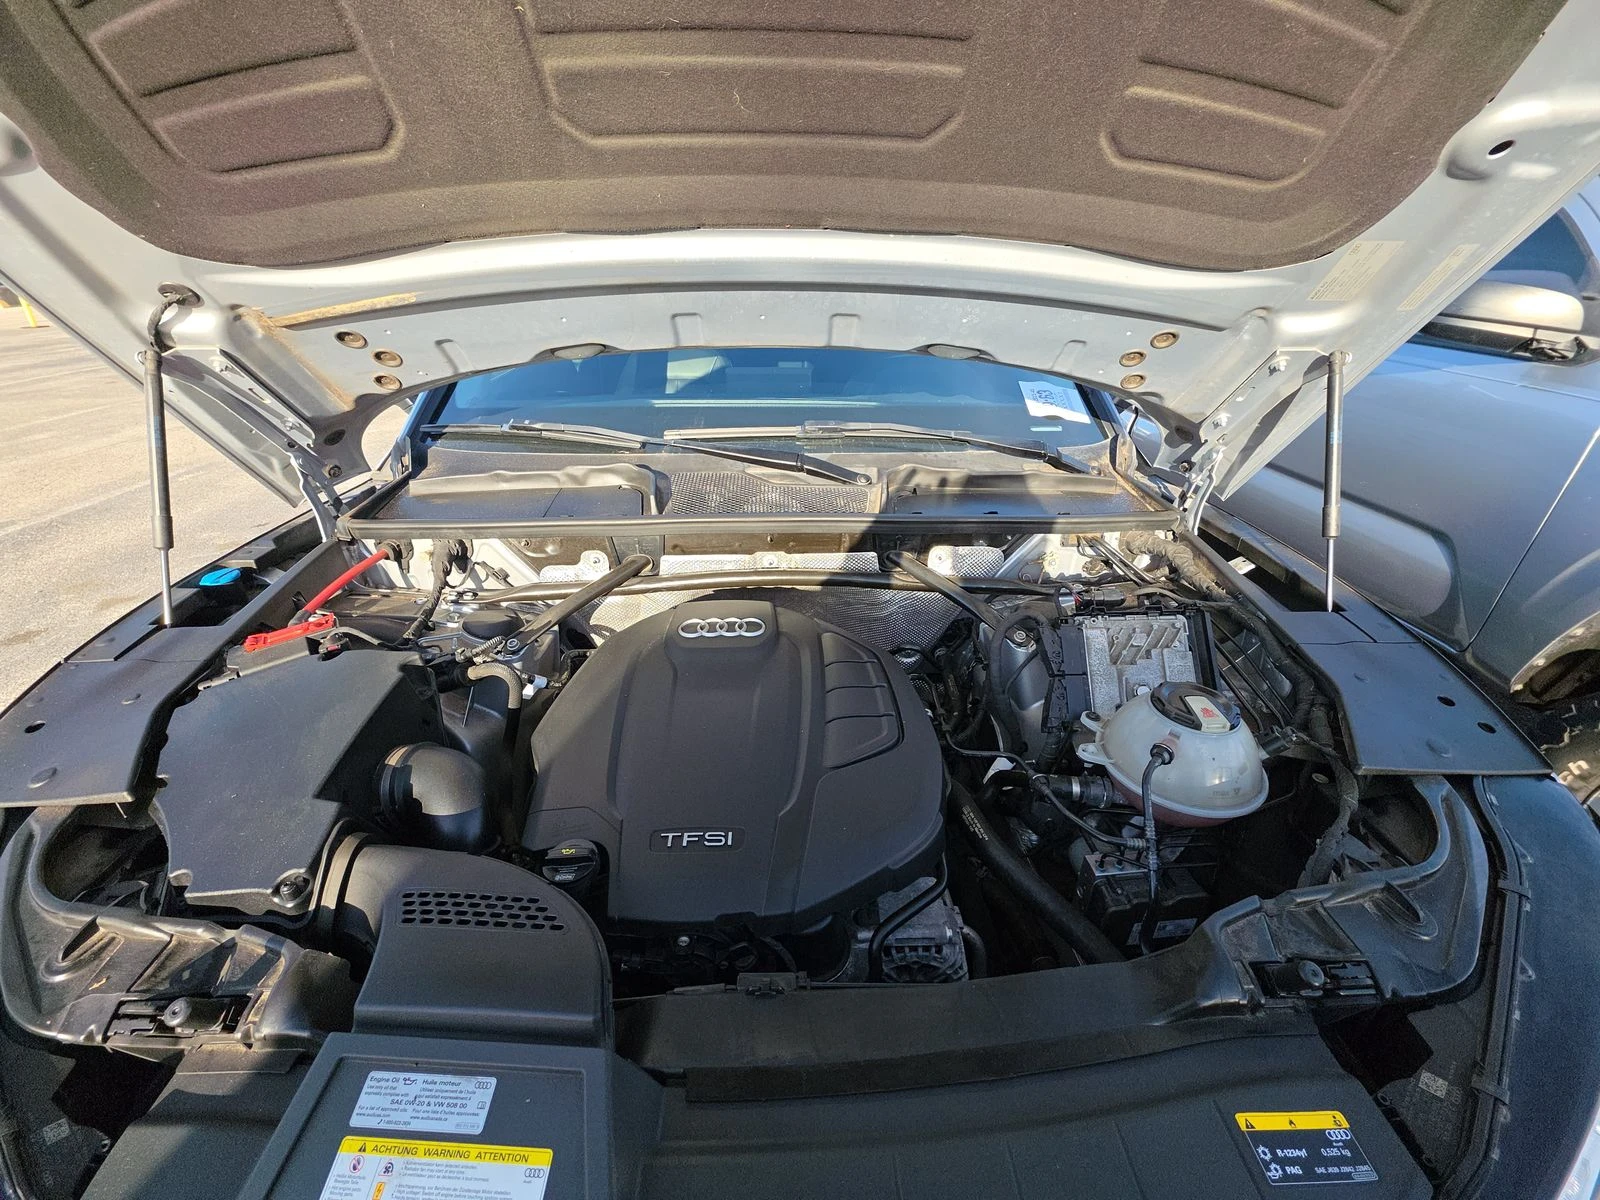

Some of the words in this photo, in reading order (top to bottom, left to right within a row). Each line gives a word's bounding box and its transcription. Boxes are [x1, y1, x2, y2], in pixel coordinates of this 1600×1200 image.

[660, 831, 733, 847] TFSI
[370, 1075, 390, 1083] Engine
[390, 1098, 404, 1106] SAE
[371, 1144, 418, 1156] ACHTUNG
[423, 1147, 470, 1159] WARNING
[475, 1151, 529, 1163] ATTENTION
[1320, 1147, 1341, 1157] 0,525
[1340, 1148, 1351, 1157] kg
[1285, 1165, 1303, 1174] PAG
